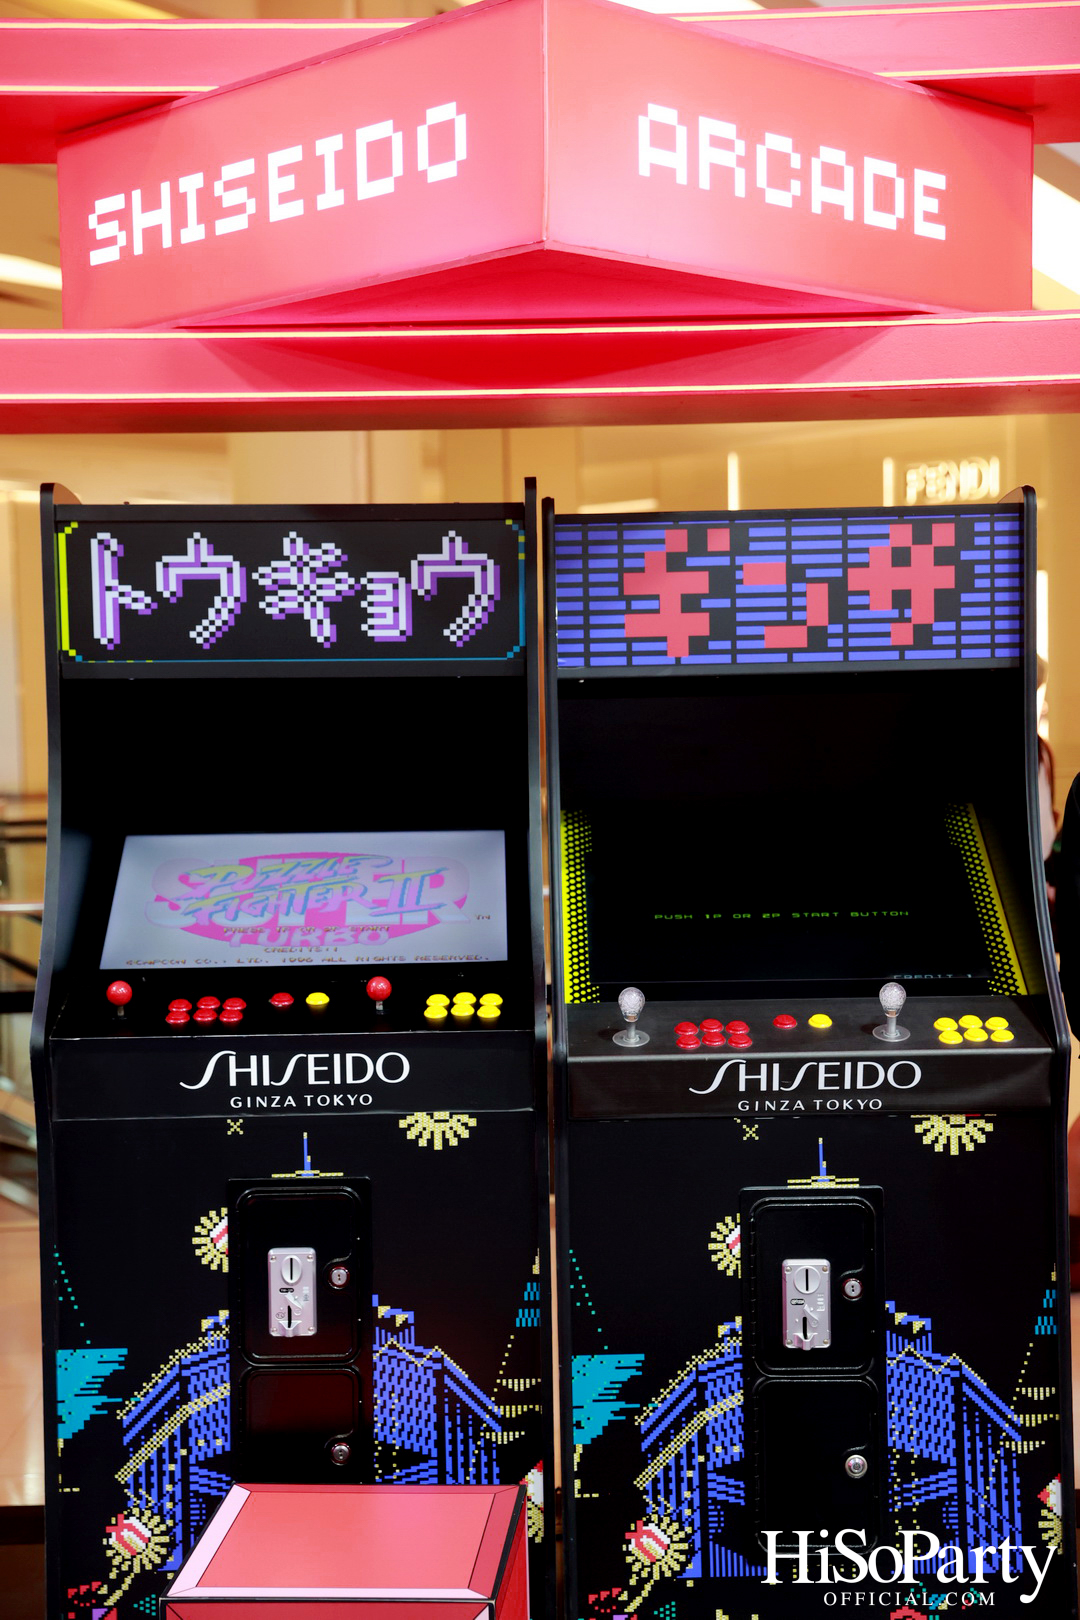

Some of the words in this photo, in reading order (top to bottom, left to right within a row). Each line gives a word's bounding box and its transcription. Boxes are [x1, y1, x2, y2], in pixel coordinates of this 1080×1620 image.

[88, 101, 468, 266] SHISEIDO
[638, 103, 947, 241] ARCADE
[90, 530, 502, 651] トウキョウ
[623, 522, 956, 658] ギンザ
[224, 927, 390, 948] TURBO
[180, 1050, 411, 1090] SHISEIDO
[688, 1059, 922, 1095] SHISEIDO
[230, 1096, 297, 1109] GINZA
[304, 1093, 373, 1107] TOKYO
[738, 1099, 805, 1112] GINZA
[813, 1098, 883, 1111] TOKYO
